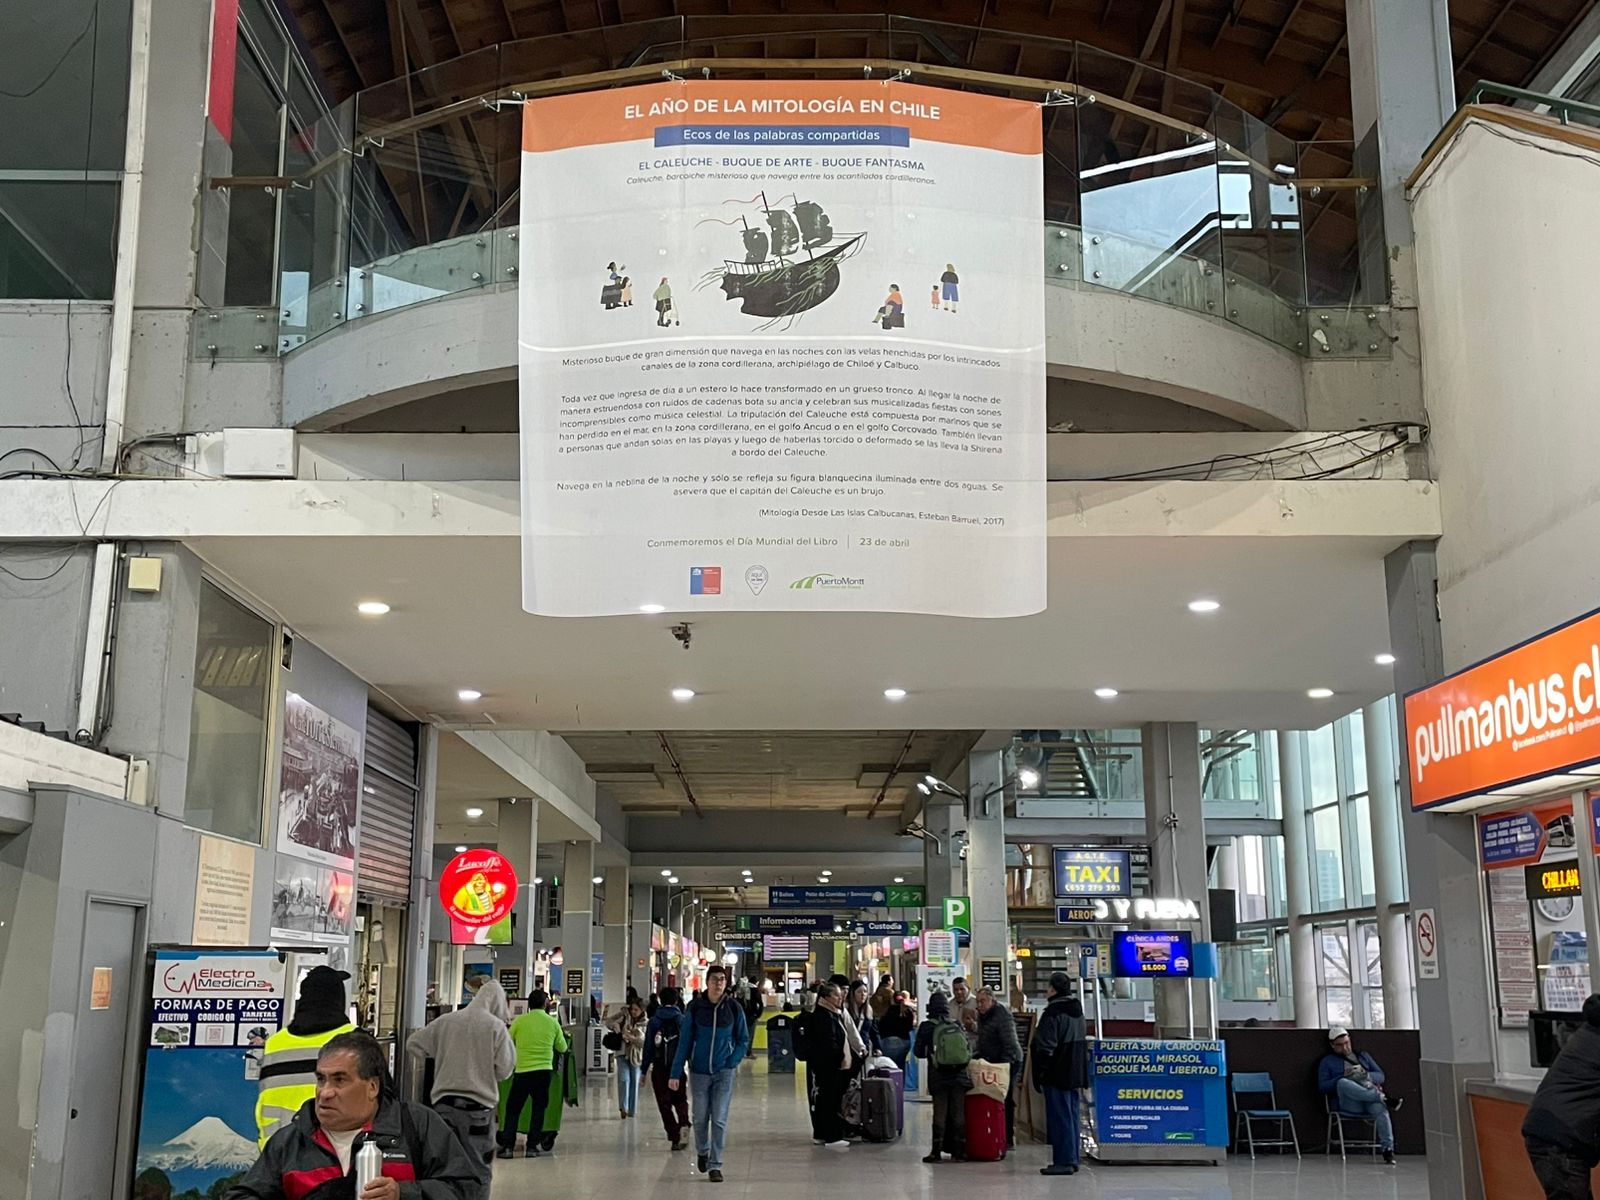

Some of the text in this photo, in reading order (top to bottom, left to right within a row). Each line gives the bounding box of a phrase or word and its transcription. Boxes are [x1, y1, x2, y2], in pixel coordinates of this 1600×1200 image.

[624, 96, 940, 119] EL AÑO DE LA MITOLOGÍA EN CHILE
[683, 129, 880, 141] Ecos de las palabras compartidas
[638, 157, 924, 170] EL CALEUCHE BUQUE DE ARTE BUQUE FANTASMA
[562, 356, 603, 365] Misterioso
[604, 354, 630, 362] buque
[644, 350, 663, 360] gran
[665, 348, 709, 356] dimensión
[882, 348, 926, 358] henchidas
[942, 354, 954, 362] los
[956, 356, 1000, 367] intrincados
[640, 362, 673, 371] canales
[628, 414, 651, 422] como
[740, 410, 786, 418] tripulación
[806, 409, 847, 418] Caleuche
[871, 411, 919, 420] compuesta
[938, 417, 970, 426] marinos
[972, 420, 988, 428] que
[790, 486, 832, 494] Caleuche
[801, 508, 828, 516] Desde
[918, 511, 949, 520] Esteban
[983, 517, 1004, 525] 2017)
[646, 536, 838, 547] Conmemoremos el Día Mundial del Libro
[859, 537, 872, 545] 23
[816, 577, 865, 586] PuertoMontt
[1415, 644, 1600, 783] pullmanbus.cl
[1065, 866, 1120, 882] TAXI
[946, 900, 966, 926] P
[1113, 898, 1130, 919] Y
[760, 917, 816, 925] Informaciones
[868, 922, 902, 930] Custodia
[199, 968, 256, 978] Electro
[197, 978, 267, 988] Medicina
[154, 999, 280, 1010] FORMAS DE PAGO
[158, 1013, 188, 1022] EFECTIVO
[225, 1014, 235, 1022] QR
[1165, 1042, 1221, 1051] CARDONAL
[1095, 1055, 1150, 1064] LAGUNITAS
[1156, 1055, 1202, 1063] MIRASOL
[1097, 1064, 1164, 1074] BOSQUE MAR
[1170, 1066, 1218, 1074] LIBERTAD
[1118, 1089, 1184, 1099] SERVICIOS
